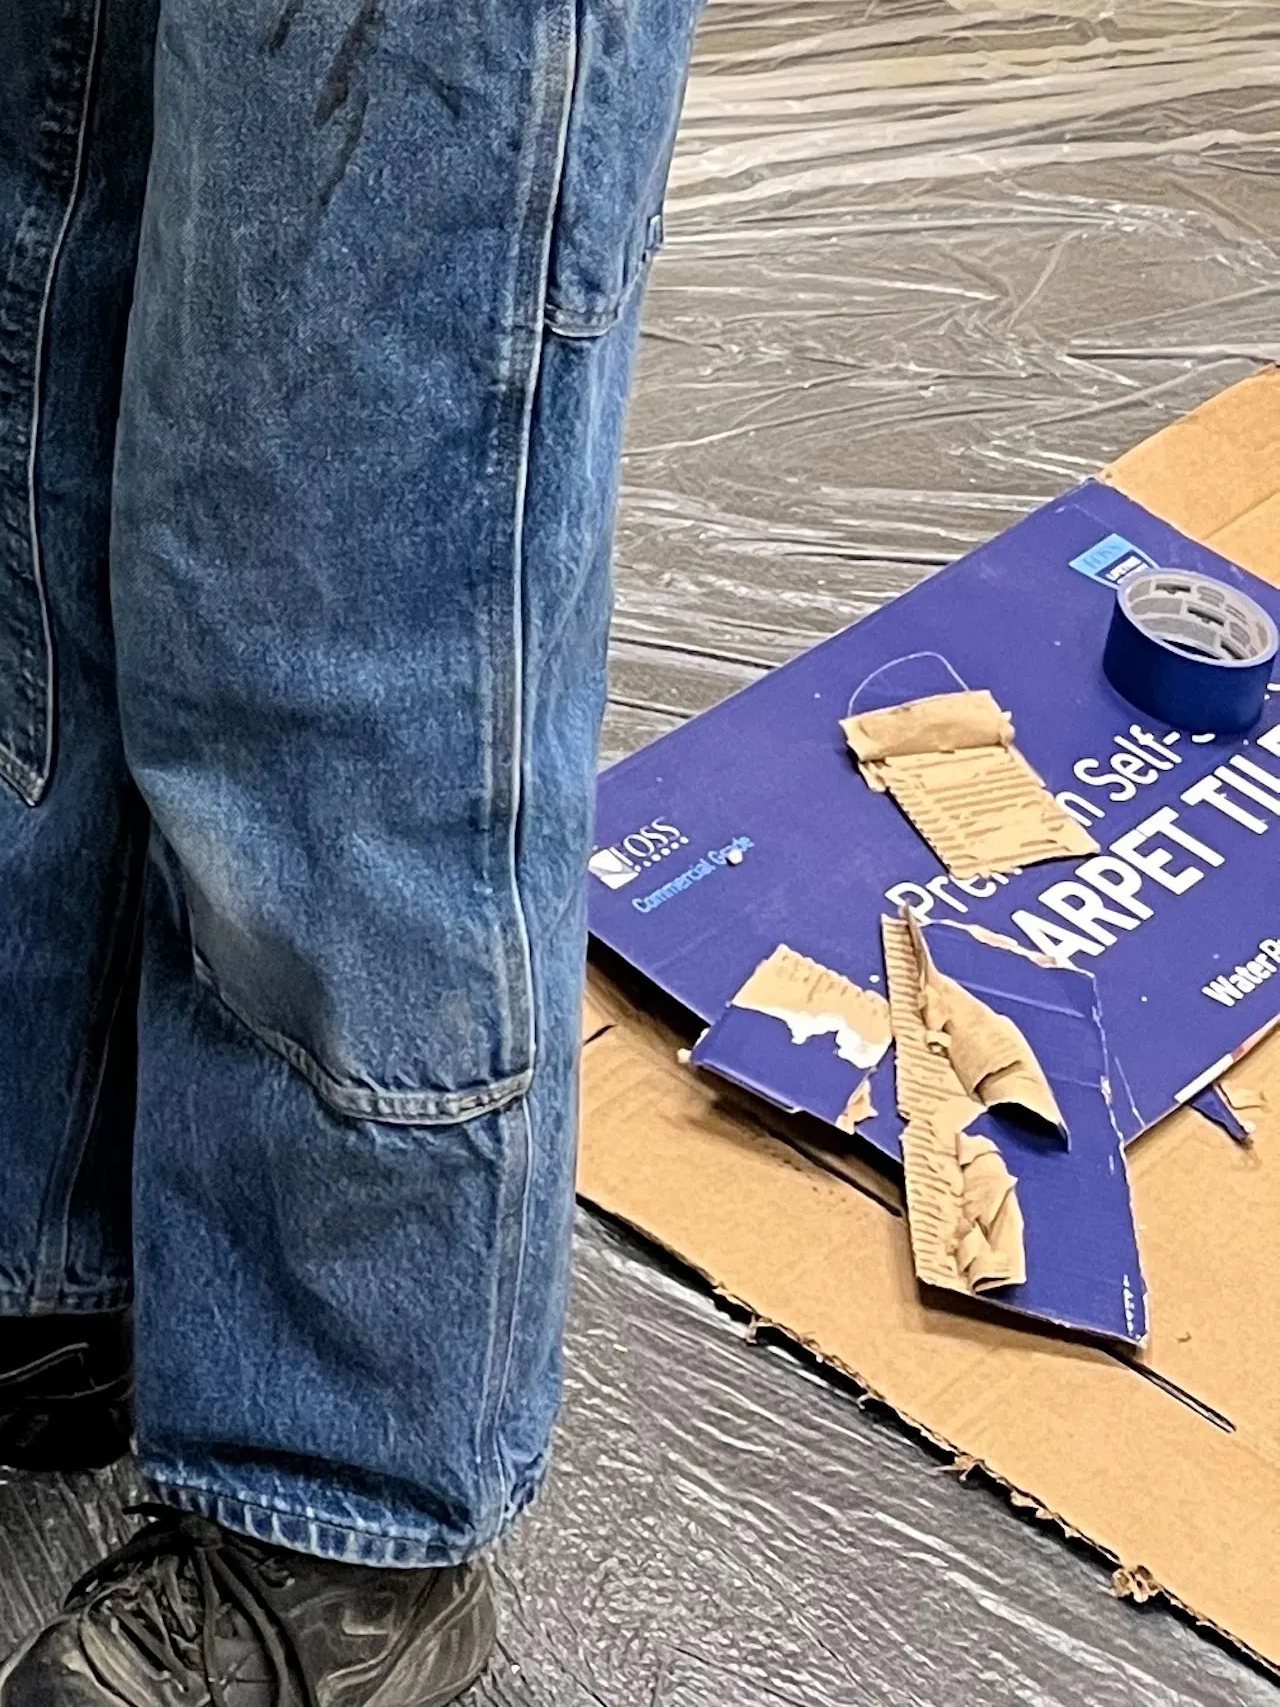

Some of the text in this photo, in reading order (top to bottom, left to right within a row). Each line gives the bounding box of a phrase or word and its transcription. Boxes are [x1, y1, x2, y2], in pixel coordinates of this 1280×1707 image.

[631, 858, 716, 914] Commercial
[1011, 806, 1226, 965] ARPET
[1202, 952, 1277, 1007] Water
